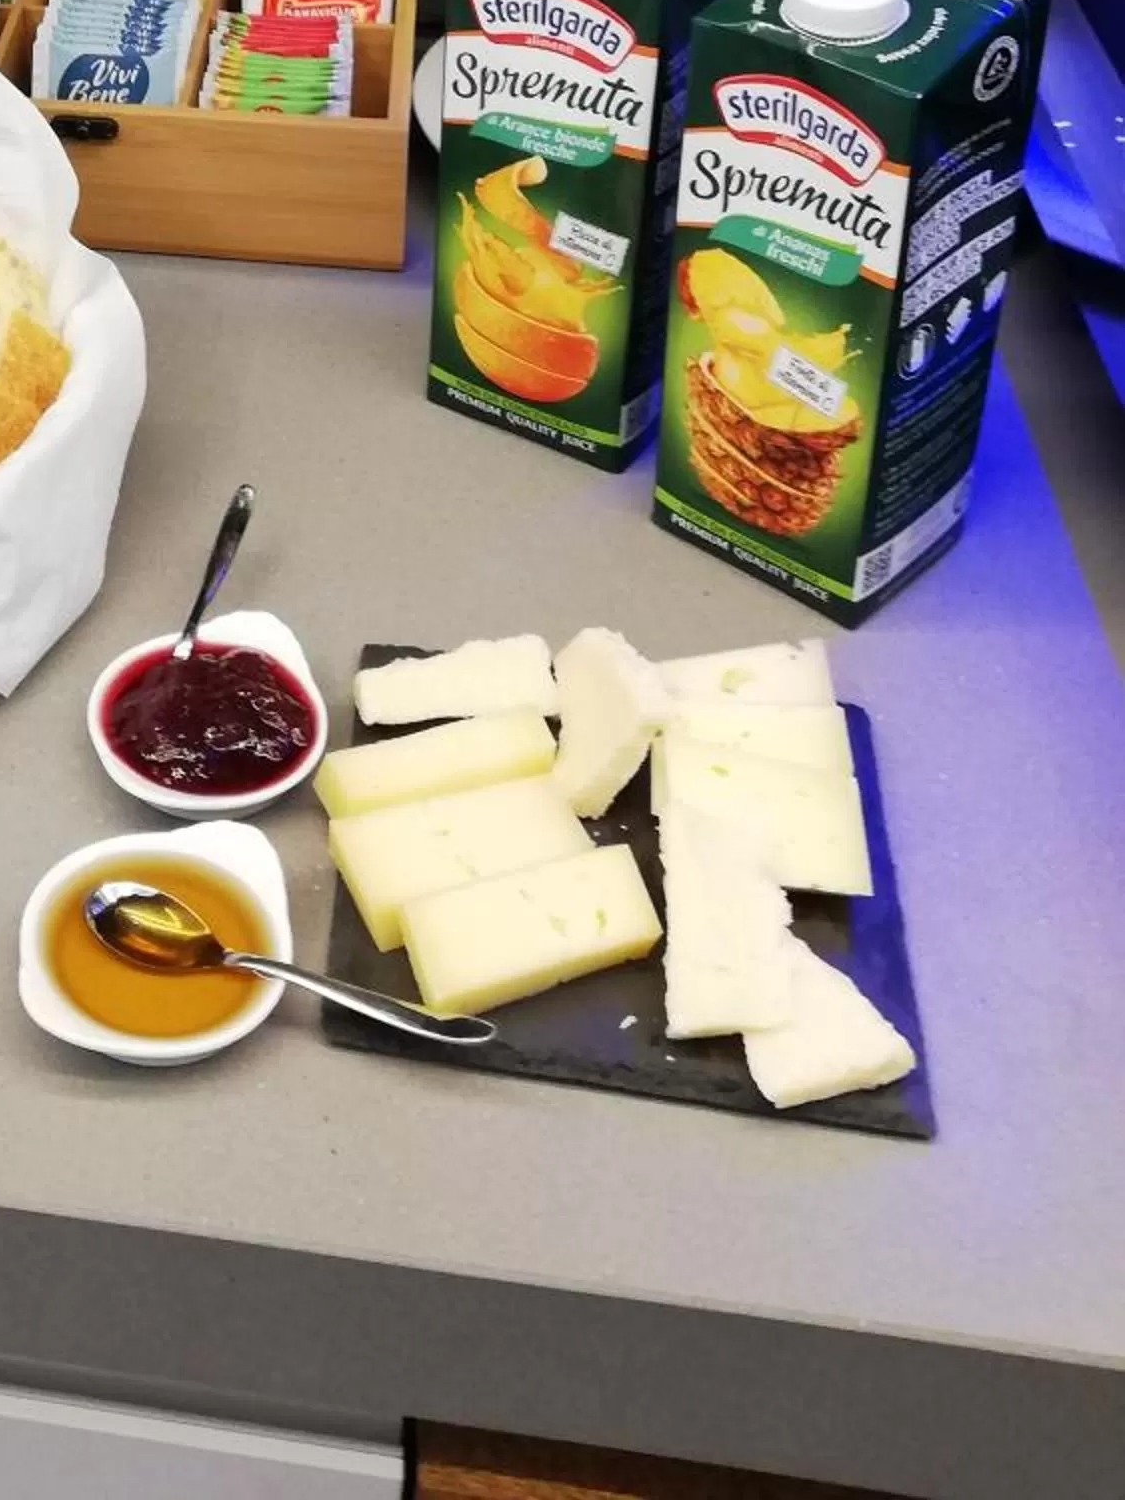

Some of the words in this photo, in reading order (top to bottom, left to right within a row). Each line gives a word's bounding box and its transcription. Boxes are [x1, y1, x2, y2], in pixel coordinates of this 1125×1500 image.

[66, 78, 131, 103] Bene
[90, 58, 141, 87] Vivi
[452, 52, 644, 127] Spremuta
[728, 90, 869, 168] sterilgarda
[689, 149, 892, 250] Spremuta
[765, 243, 824, 278] freschi
[506, 411, 558, 439] QUALITY
[562, 433, 597, 453] JUICE
